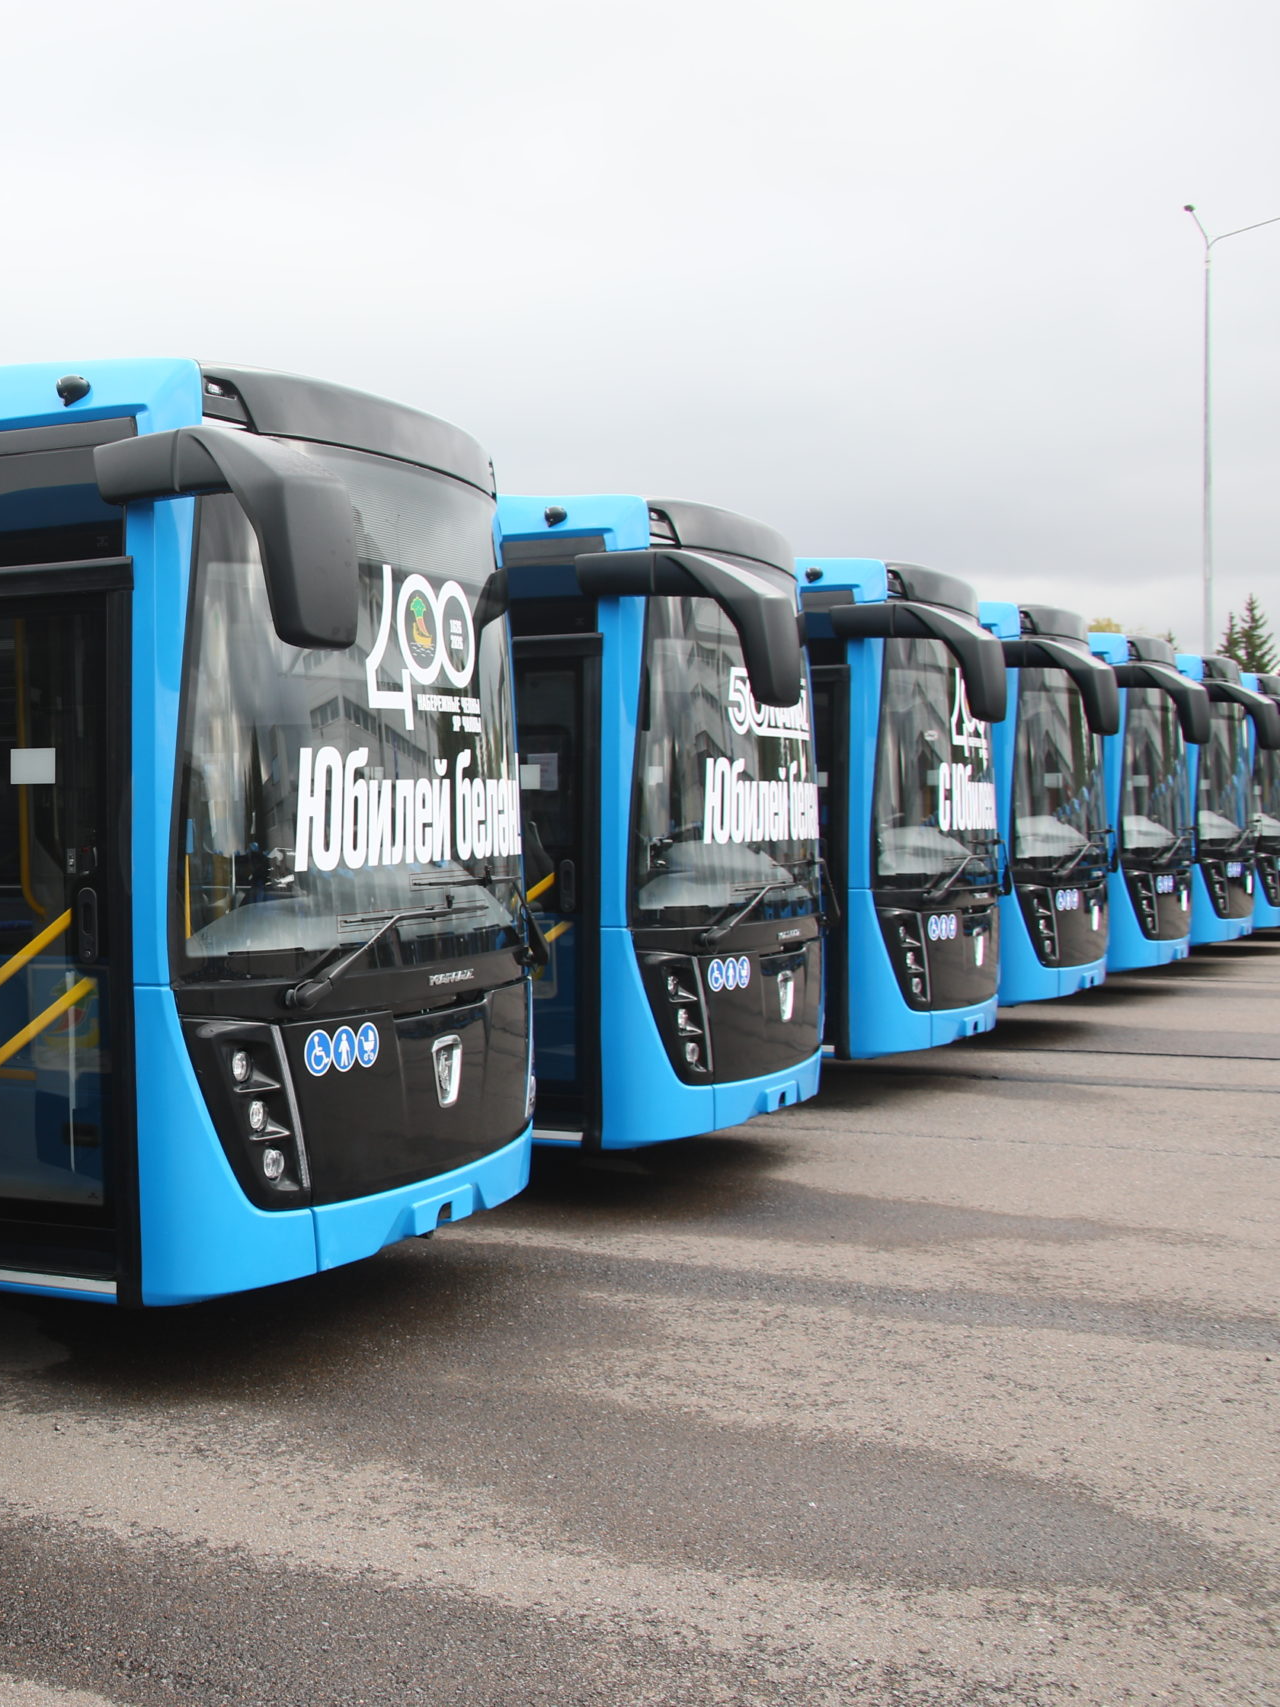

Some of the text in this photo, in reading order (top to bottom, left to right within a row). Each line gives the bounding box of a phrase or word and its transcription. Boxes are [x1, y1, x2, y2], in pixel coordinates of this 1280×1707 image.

[294, 746, 451, 872] Юбилей
[703, 757, 789, 845] Юбилей
[938, 762, 951, 832] С
